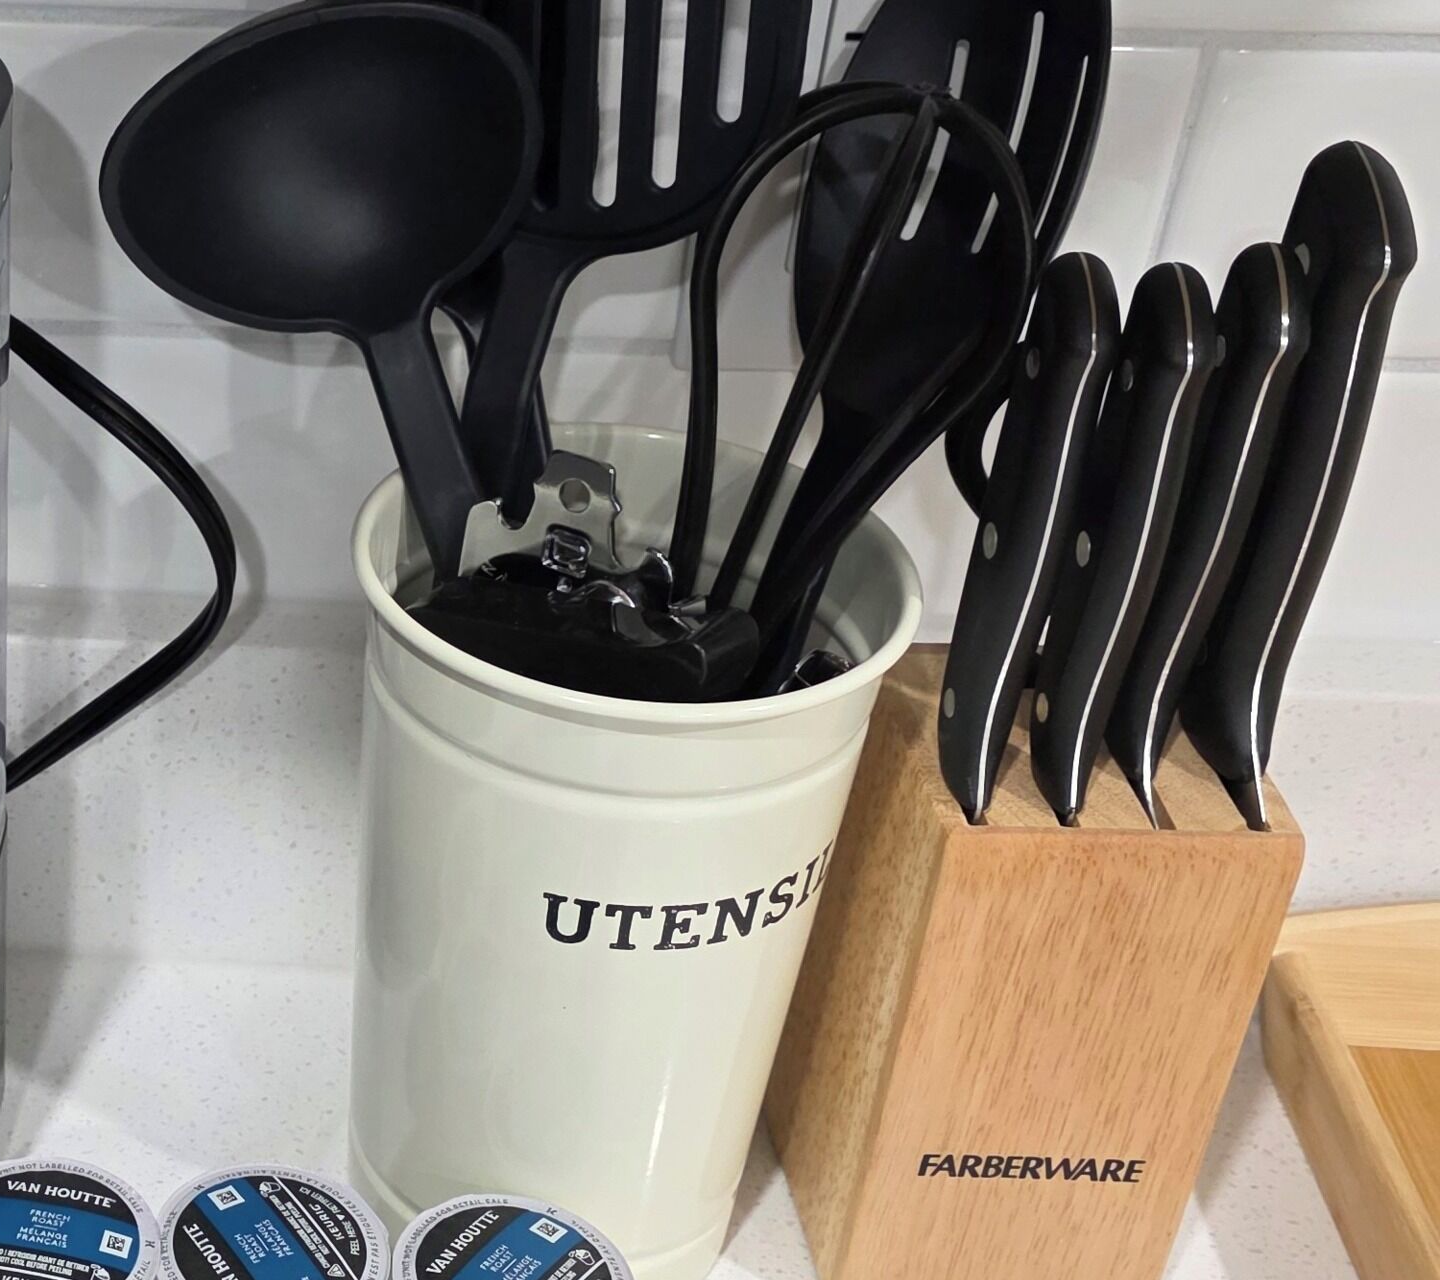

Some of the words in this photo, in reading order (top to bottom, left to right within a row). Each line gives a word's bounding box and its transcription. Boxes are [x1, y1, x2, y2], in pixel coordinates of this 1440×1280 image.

[917, 1154, 1146, 1183] FARBERWARE
[7, 1180, 42, 1194] VAN
[44, 1185, 113, 1208] HOUTTE
[30, 1209, 71, 1222] FRENCH
[32, 1216, 65, 1228] ROAST
[310, 1203, 346, 1240] KEURIG
[342, 1220, 357, 1237] HERE
[16, 1233, 68, 1249] FRANÇAIS
[19, 1226, 68, 1241] MÉLANGE
[244, 1233, 267, 1258] ROAST
[254, 1222, 286, 1258] MÉLANGE
[261, 1218, 295, 1256] FRANÇAIS
[424, 1248, 459, 1275] VAN
[449, 1210, 501, 1252] HOUTTE
[183, 1222, 231, 1274] HOUTTE
[233, 1233, 261, 1265] FRENCH
[349, 1239, 360, 1255] PEEL
[478, 1244, 509, 1270] FRENCH
[489, 1251, 515, 1273] ROAST
